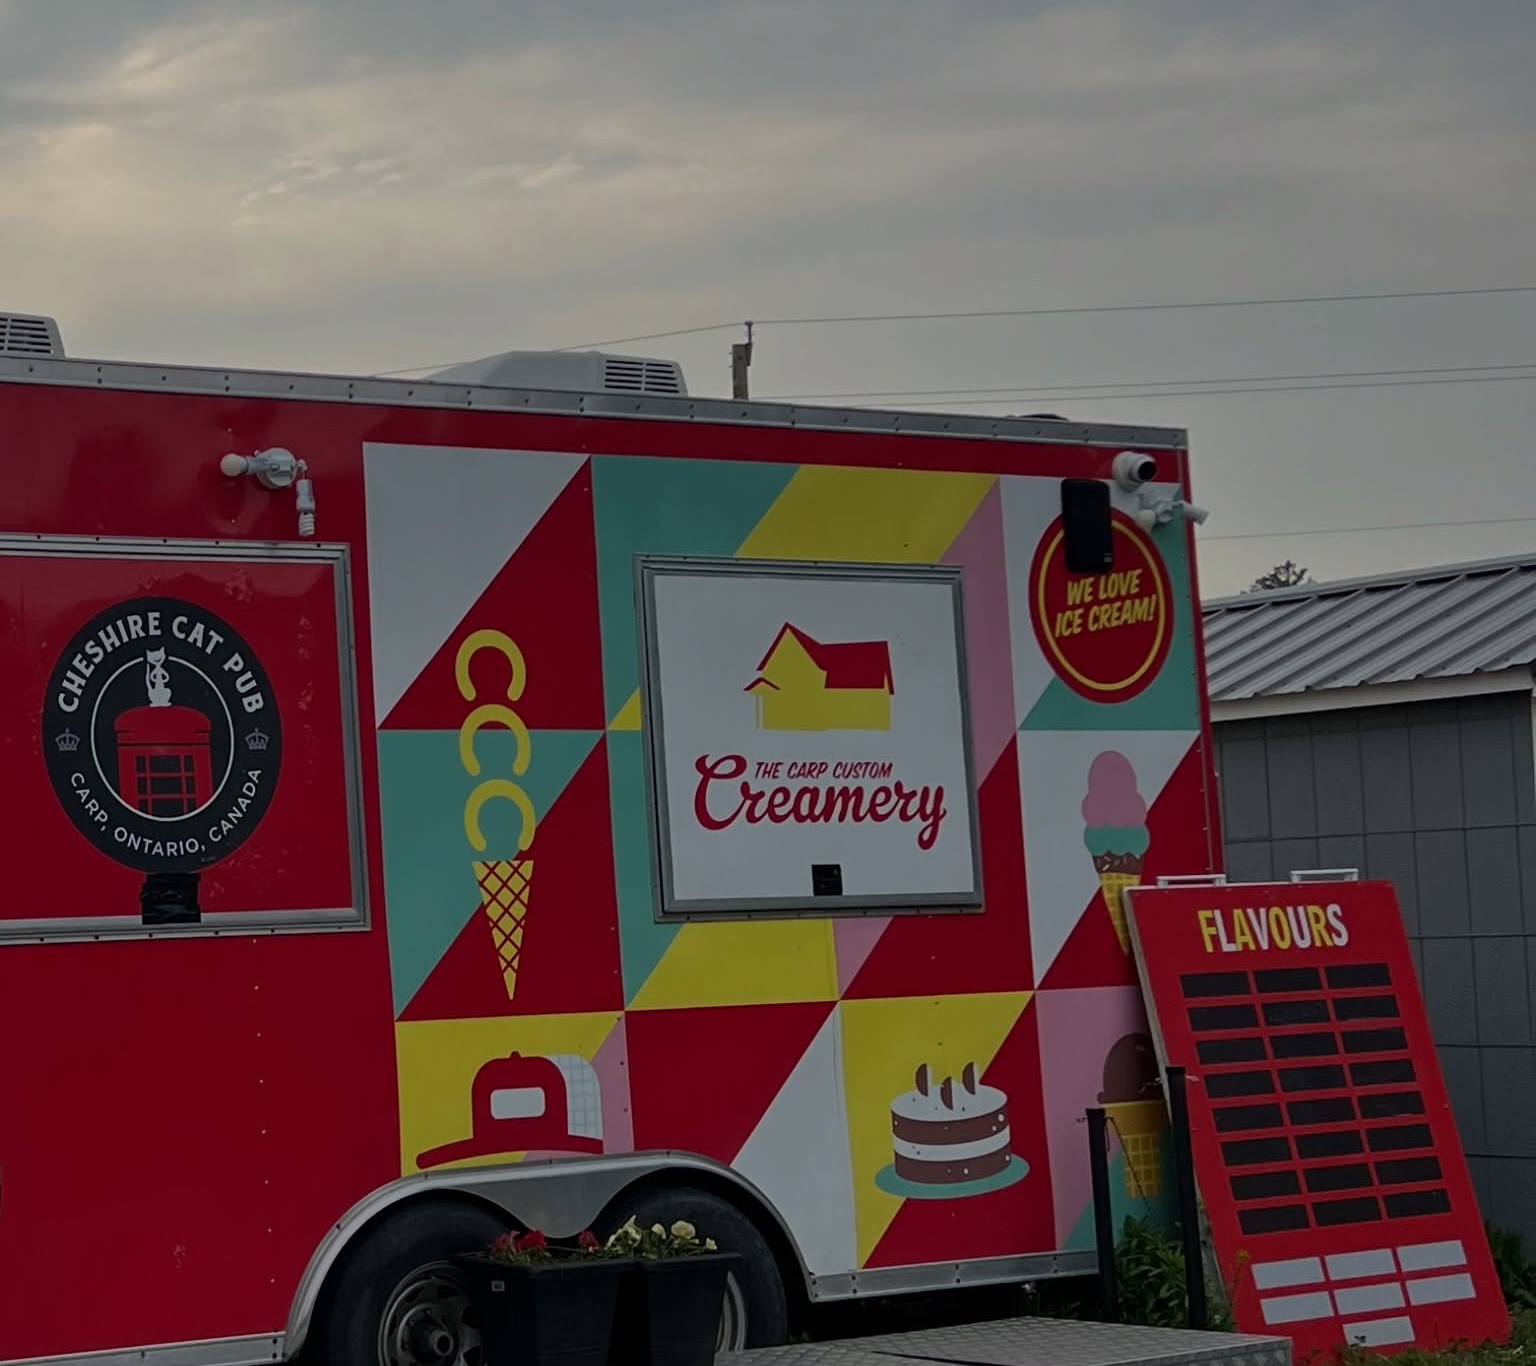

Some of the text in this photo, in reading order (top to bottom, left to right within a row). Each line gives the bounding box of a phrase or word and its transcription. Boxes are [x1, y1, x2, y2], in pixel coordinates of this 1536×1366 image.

[1067, 569, 1143, 605] WE LOVE
[1055, 595, 1157, 636] ICE CREAM!
[58, 611, 264, 714] CHESHIRE CAT PUB
[755, 762, 893, 779] THE CARP CUSTOM
[70, 768, 263, 857] CARP, ONTARIO, CANADA
[693, 753, 948, 851] Creamery
[1197, 903, 1349, 953] FLAVOURS
